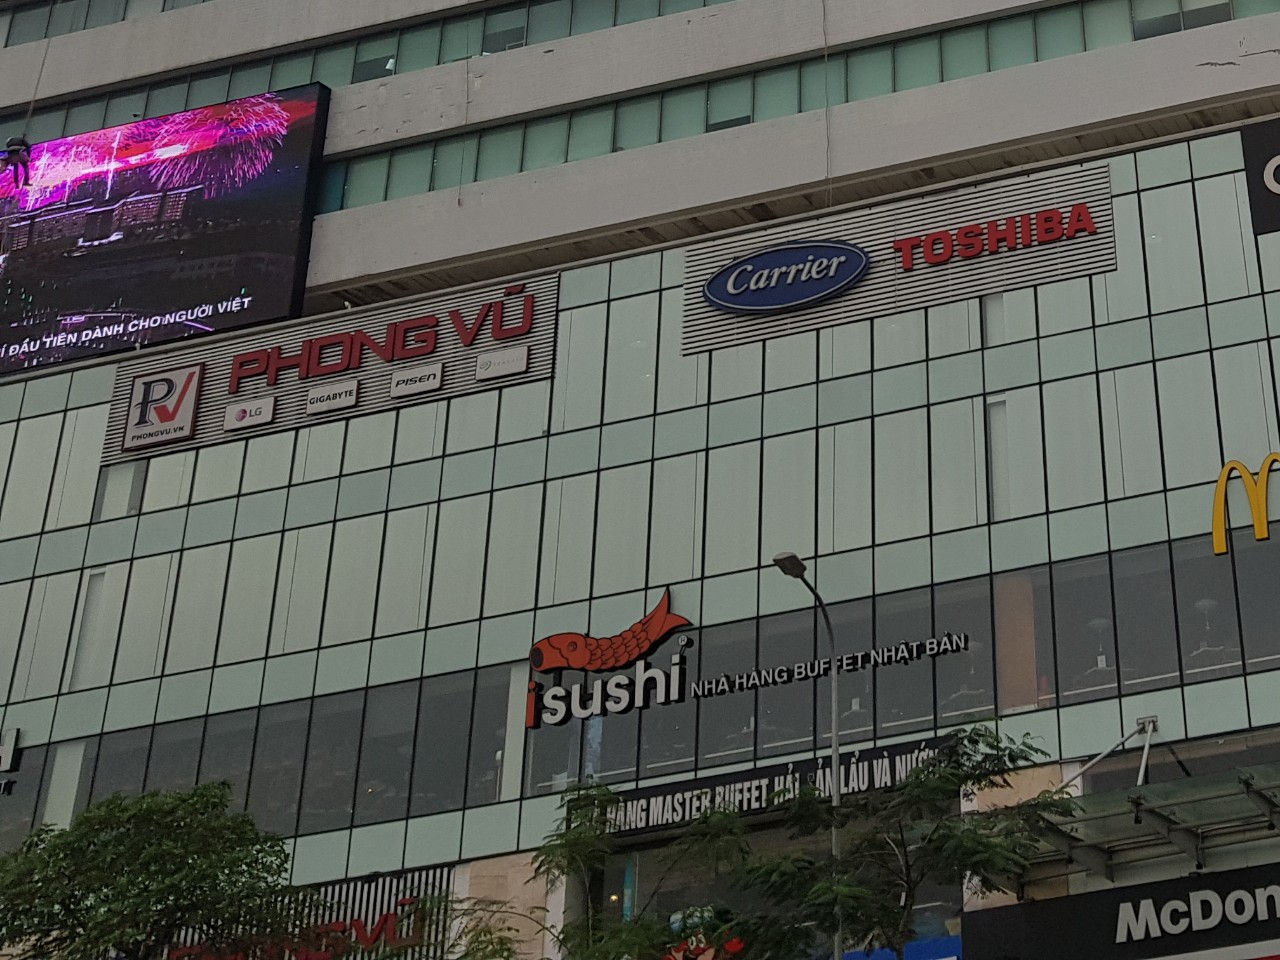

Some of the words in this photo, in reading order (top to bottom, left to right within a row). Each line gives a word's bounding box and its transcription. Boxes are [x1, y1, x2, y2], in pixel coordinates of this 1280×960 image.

[893, 202, 1097, 272] TOSHIBA
[727, 253, 847, 295] Carrier
[128, 315, 163, 333] CHO
[217, 296, 253, 315] VIỆT
[229, 315, 439, 394] PHONG
[449, 283, 534, 347] VŨ
[309, 388, 355, 405] GIGABYTE
[395, 372, 438, 388] PISEN
[249, 407, 263, 418] LG
[131, 425, 185, 442] PHONGVU.VN
[690, 673, 730, 698] NHÀ
[734, 666, 789, 690] HÀNG
[870, 640, 923, 668] NHẬT
[926, 630, 967, 656] BẢN
[649, 788, 712, 828] MASTER
[873, 750, 892, 789] VÀ
